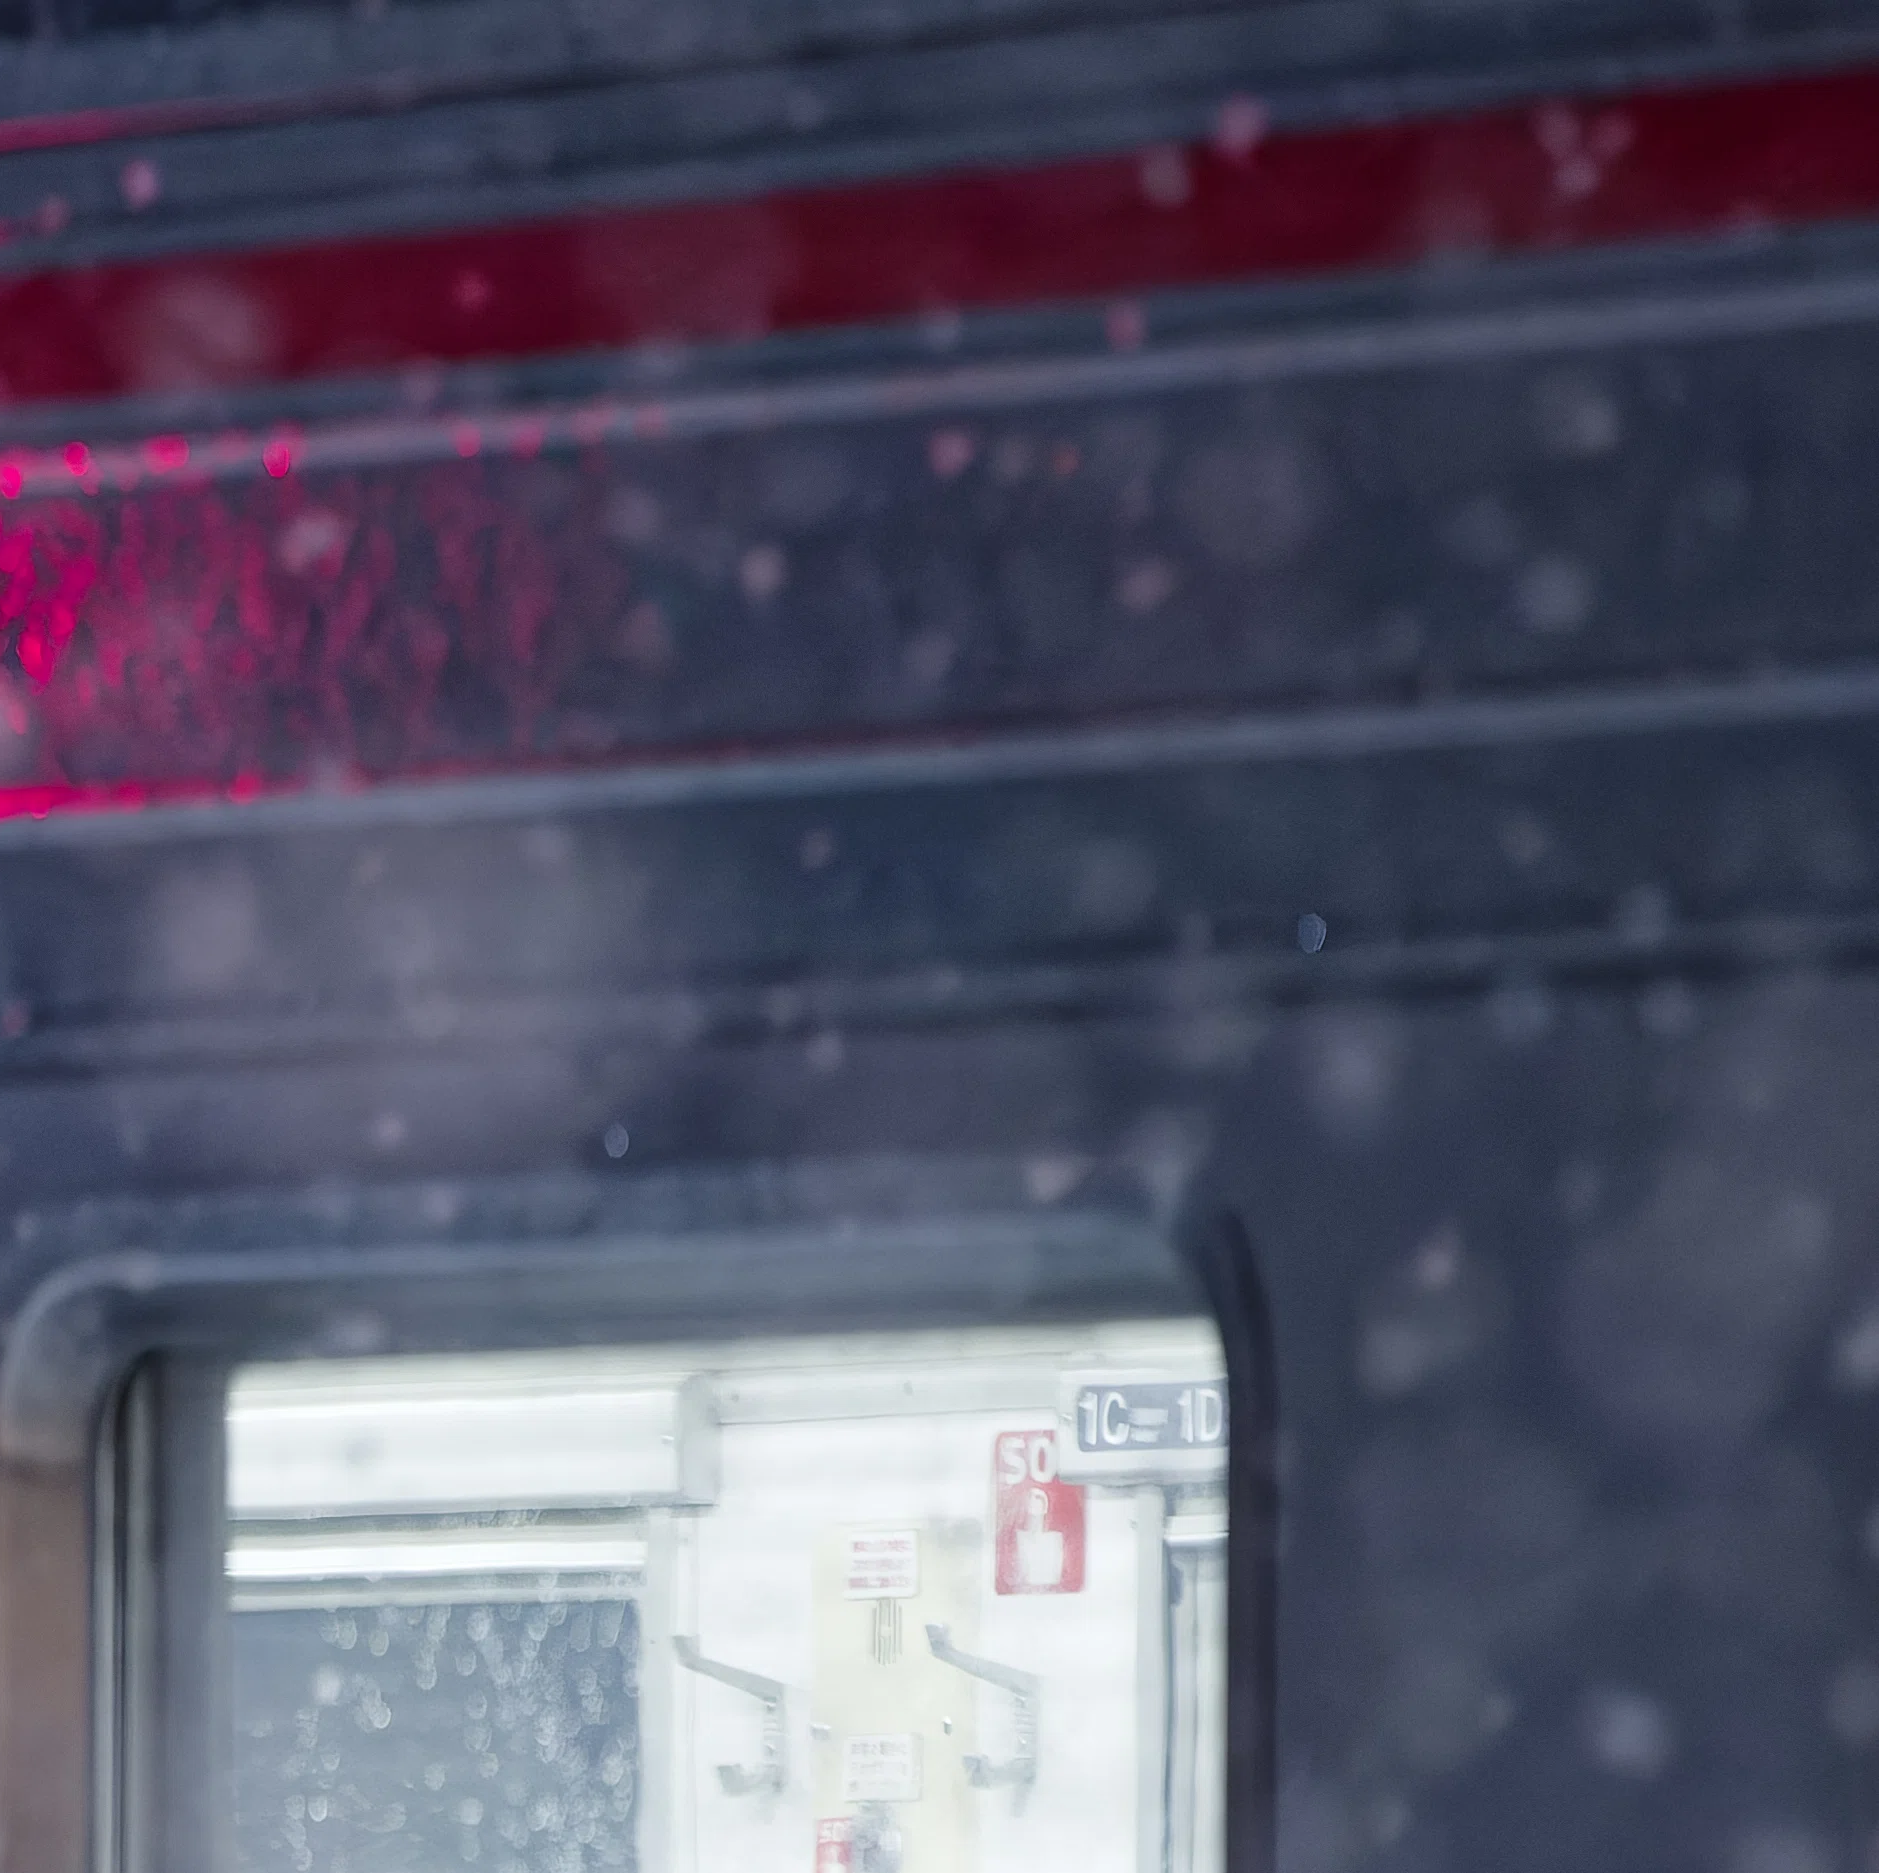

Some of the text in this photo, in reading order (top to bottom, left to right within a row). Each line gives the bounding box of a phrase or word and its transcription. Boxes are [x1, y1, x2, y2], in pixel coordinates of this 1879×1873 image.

[1078, 1387, 1224, 1446] 1C 1D
[999, 1436, 1058, 1485] SO
